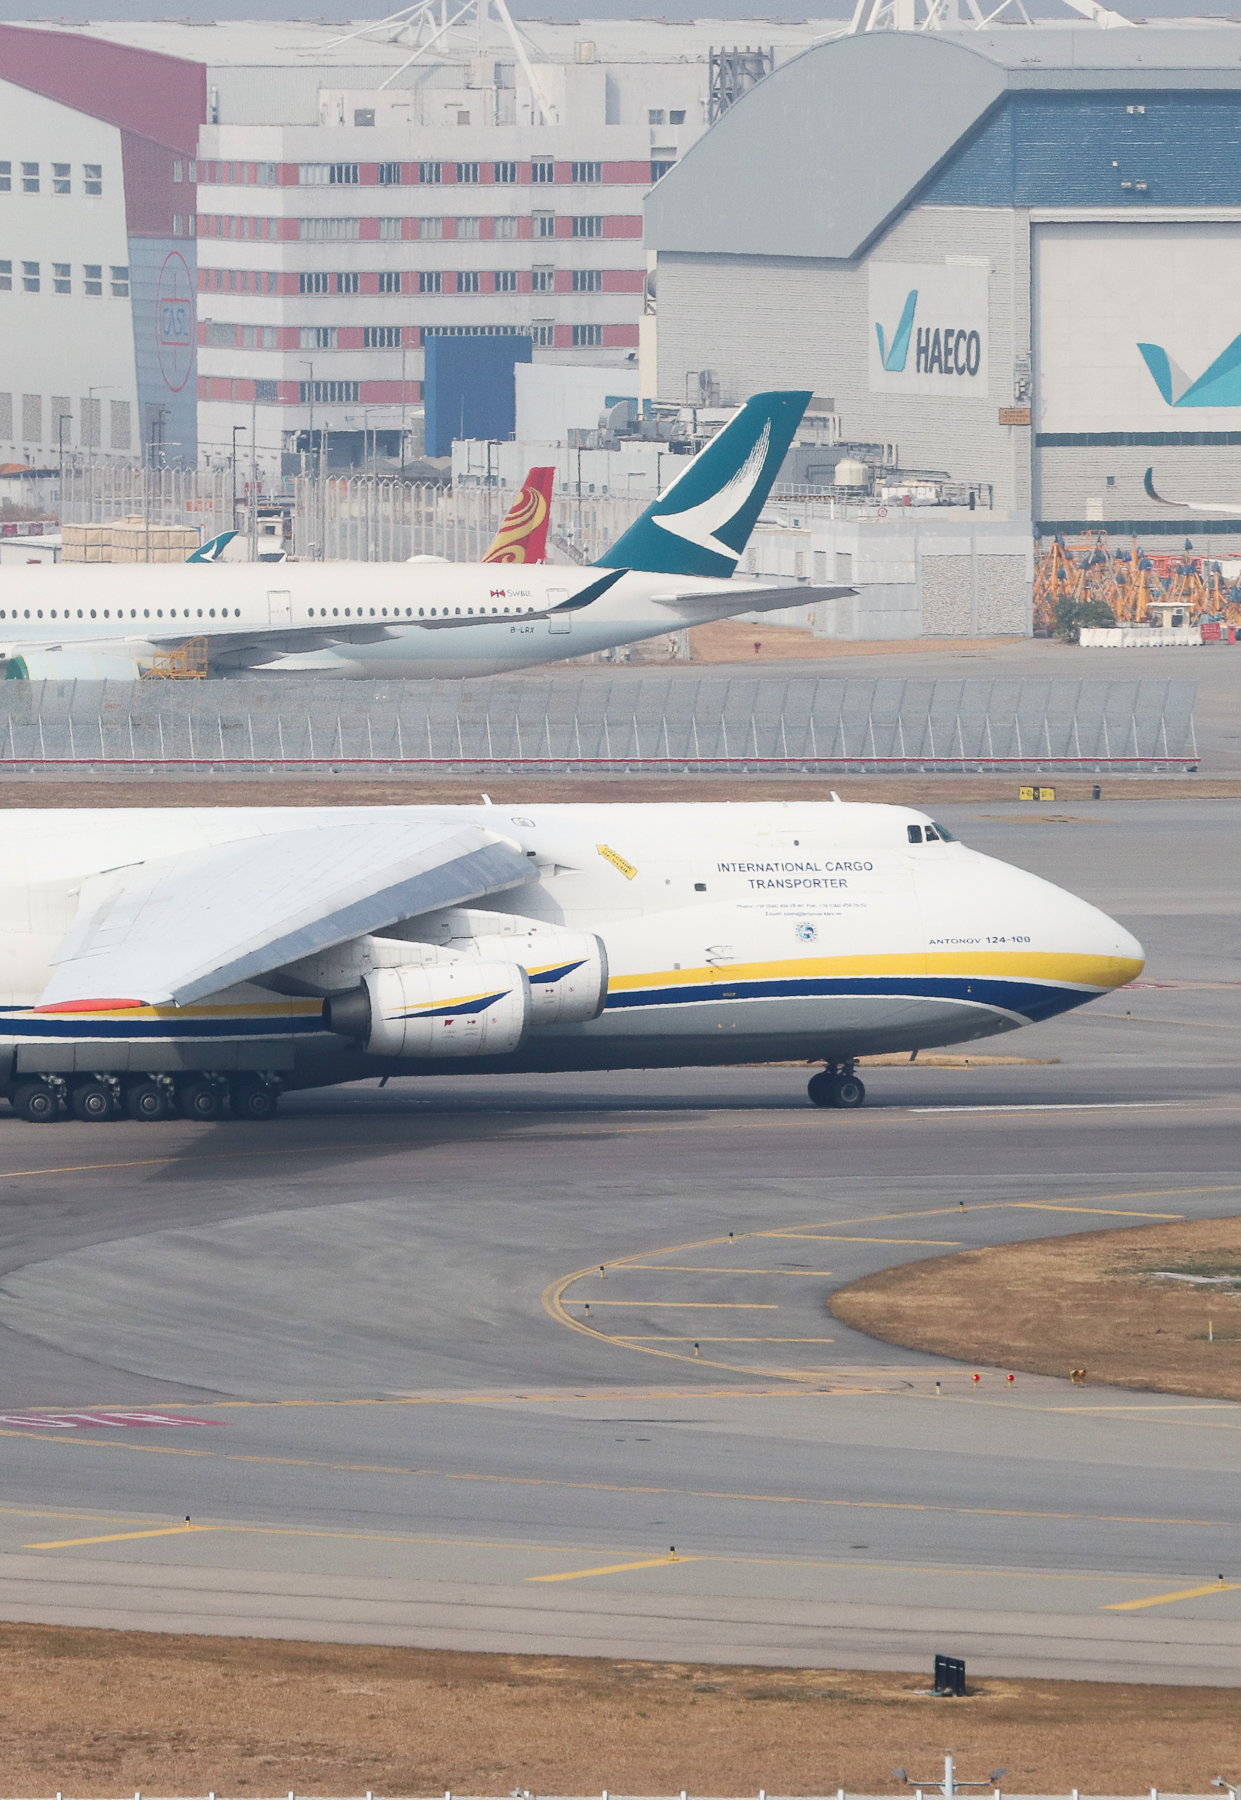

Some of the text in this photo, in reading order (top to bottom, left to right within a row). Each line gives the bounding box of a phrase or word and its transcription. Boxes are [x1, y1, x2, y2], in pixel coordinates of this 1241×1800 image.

[916, 327, 981, 377] HAECO
[717, 860, 874, 873] INTERNATIONAL CARGO
[747, 878, 849, 890] TRANSPORTER
[928, 935, 1031, 945] ANTONOV 124-100
